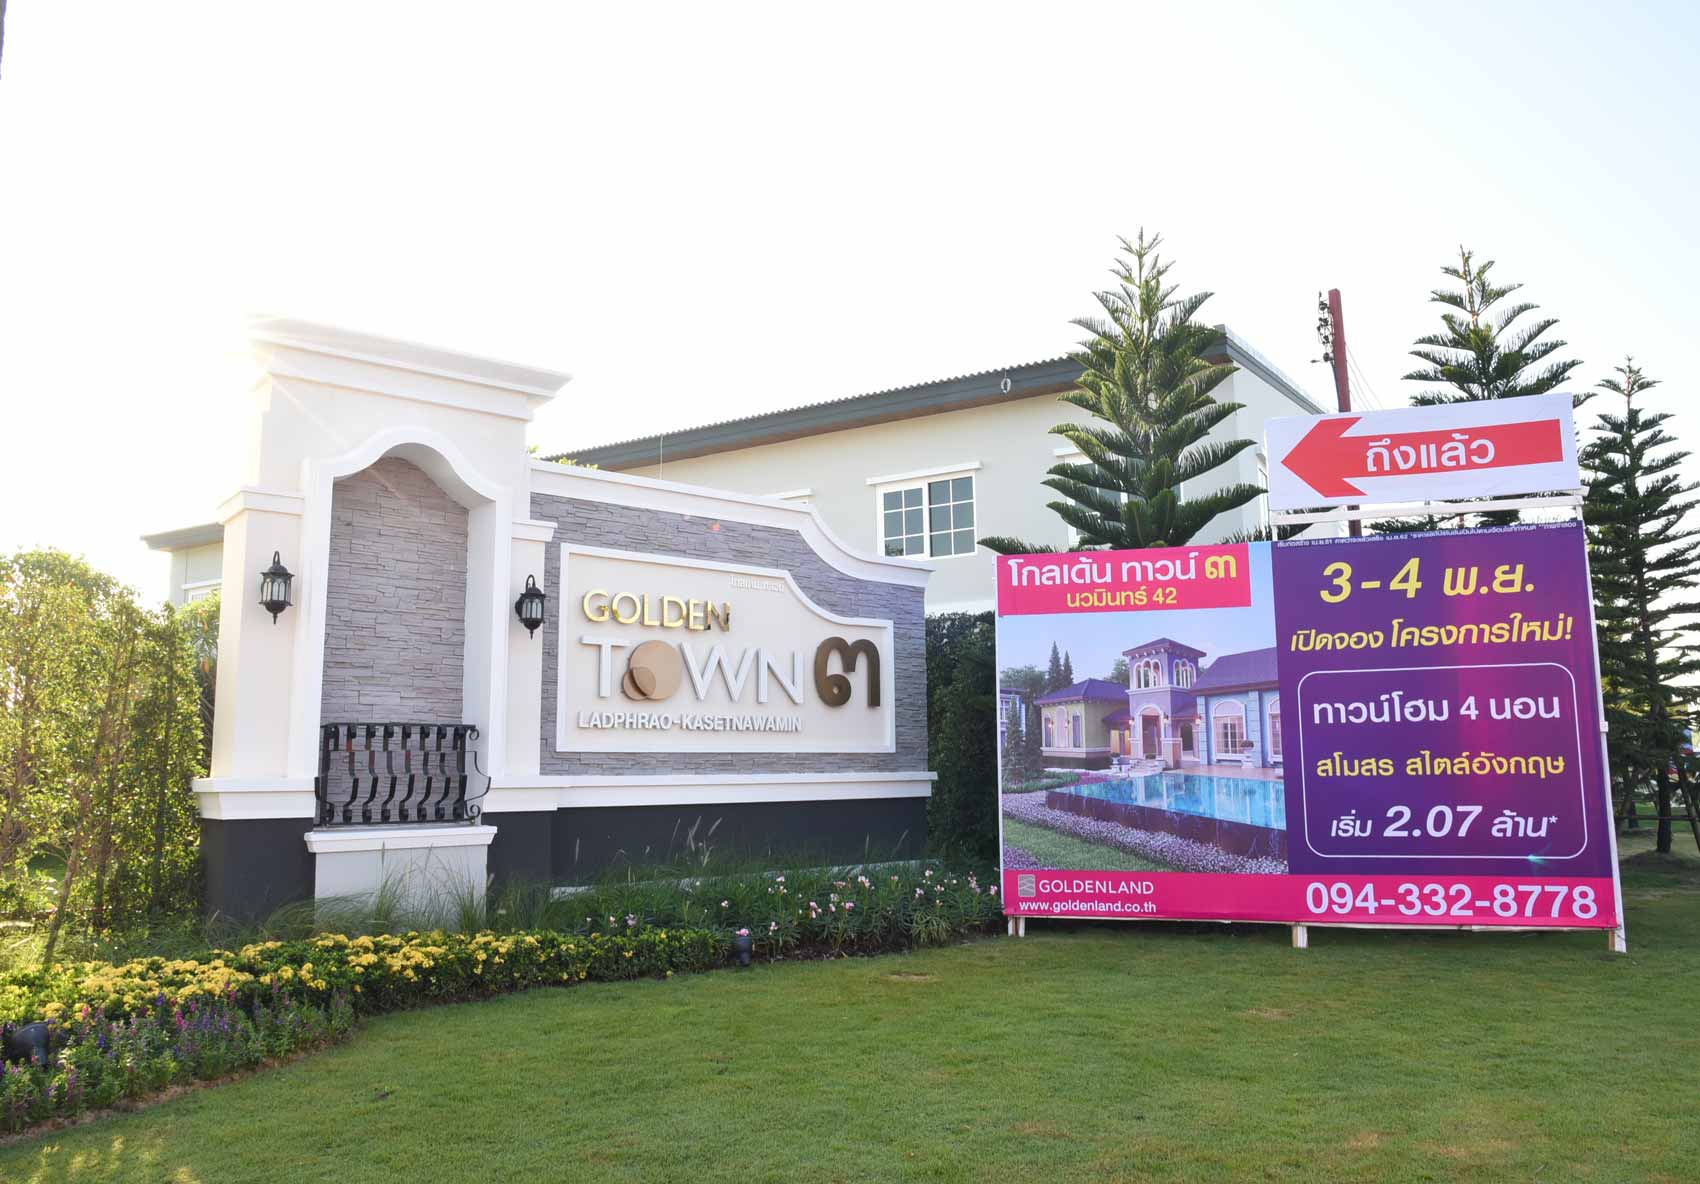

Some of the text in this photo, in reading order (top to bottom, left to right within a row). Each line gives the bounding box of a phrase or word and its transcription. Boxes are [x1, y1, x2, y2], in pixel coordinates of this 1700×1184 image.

[1366, 433, 1495, 473] ถึงแล้ว
[1008, 556, 1112, 587] โกลเด้น
[1121, 552, 1197, 583] ทาวน์
[1443, 563, 1535, 597] พ.ย.
[582, 591, 731, 632] GOLDEN
[1066, 585, 1177, 608] นวมินทร์ 42
[1290, 612, 1574, 652] เปิดจอง โครงการใหม่!
[578, 712, 802, 732] LADPHRAO-KASETNAWAMIN
[1313, 690, 1561, 724] ทาวน์โฮม 4 นอน
[1316, 750, 1565, 779] สโมสร สไตล์อังกฤษ
[1330, 809, 1373, 838] เริ่ม
[1383, 805, 1483, 838] 2.07
[1039, 879, 1154, 895] GOLDENLAND
[1306, 882, 1598, 919] 094-332-8778
[1019, 900, 1157, 913] www.goldenland.co.th
